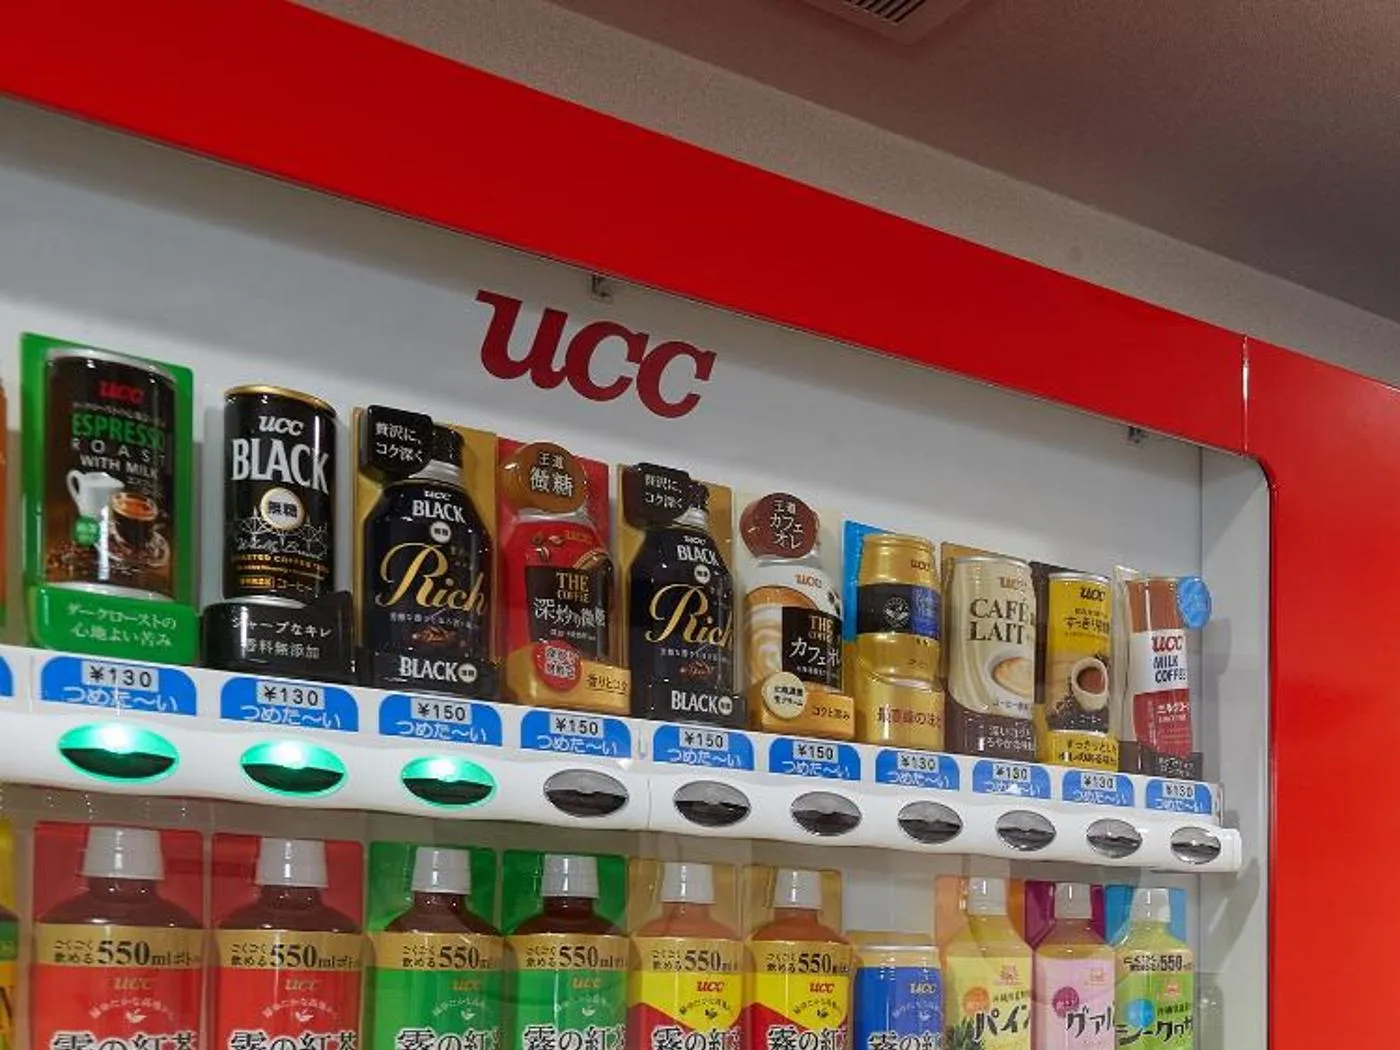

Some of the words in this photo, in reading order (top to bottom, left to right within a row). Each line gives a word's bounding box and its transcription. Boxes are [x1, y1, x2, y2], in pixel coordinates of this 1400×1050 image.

[80, 455, 120, 473] WITH
[232, 438, 331, 495] BLACK
[412, 500, 466, 523] BLACK
[677, 544, 720, 566] BLACK
[376, 542, 485, 613] Rich
[556, 572, 589, 592] THE
[967, 621, 1026, 645] LATT
[400, 656, 458, 682] BLACK
[1153, 655, 1179, 668] MILK
[90, 664, 152, 688] ¥130
[264, 685, 319, 707] ¥130
[671, 690, 718, 714] BLACK
[416, 701, 466, 721] ¥150
[555, 717, 600, 737] ¥150
[683, 731, 724, 749] ¥150
[797, 744, 834, 761] ¥150
[901, 756, 937, 772] ¥130
